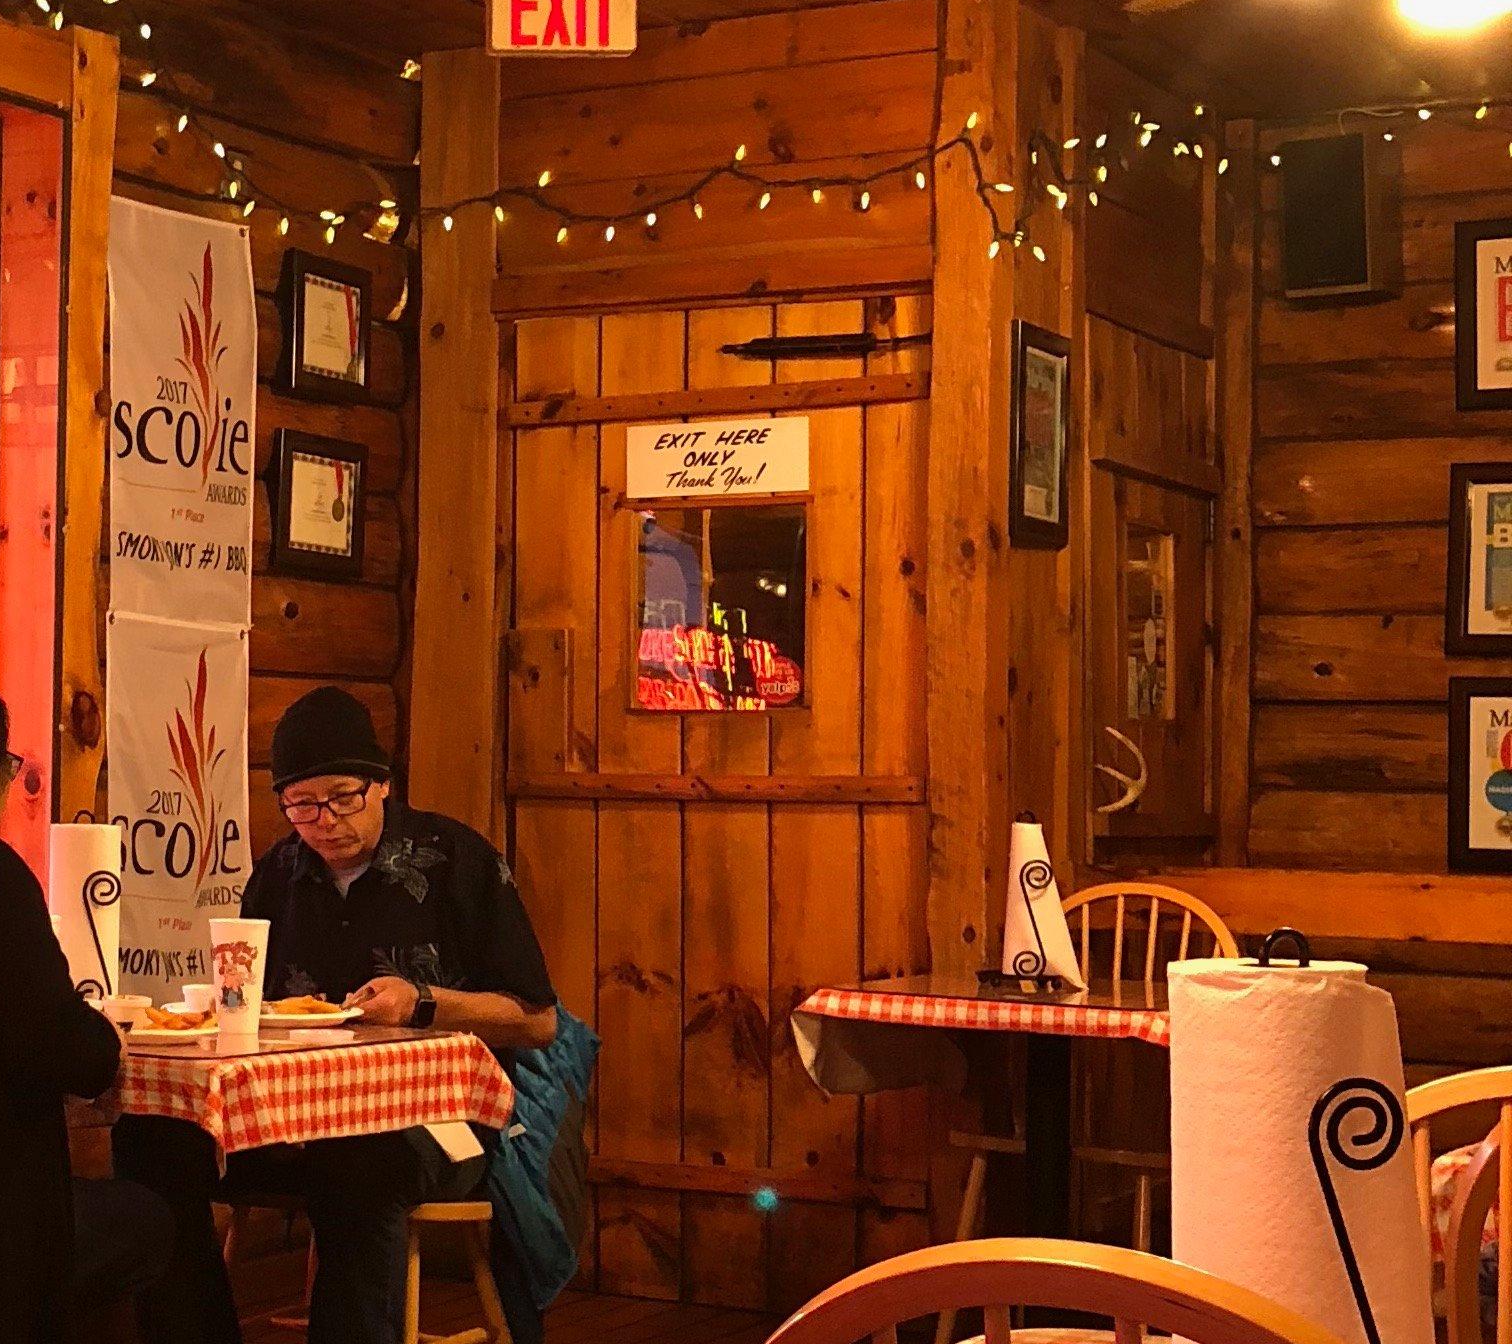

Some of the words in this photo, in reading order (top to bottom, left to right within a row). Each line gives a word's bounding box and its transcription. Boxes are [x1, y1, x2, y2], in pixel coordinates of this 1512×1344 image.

[156, 375, 188, 405] 2017
[654, 431, 706, 451] EXIT
[714, 428, 772, 446] HERE
[683, 450, 736, 467] ONLY
[666, 468, 718, 489] Thank
[720, 462, 767, 493] You!
[205, 483, 248, 506] AWARDS
[199, 542, 221, 570] #1
[225, 545, 248, 576] BBQ
[146, 789, 182, 816] 2017
[186, 948, 205, 976] #1
